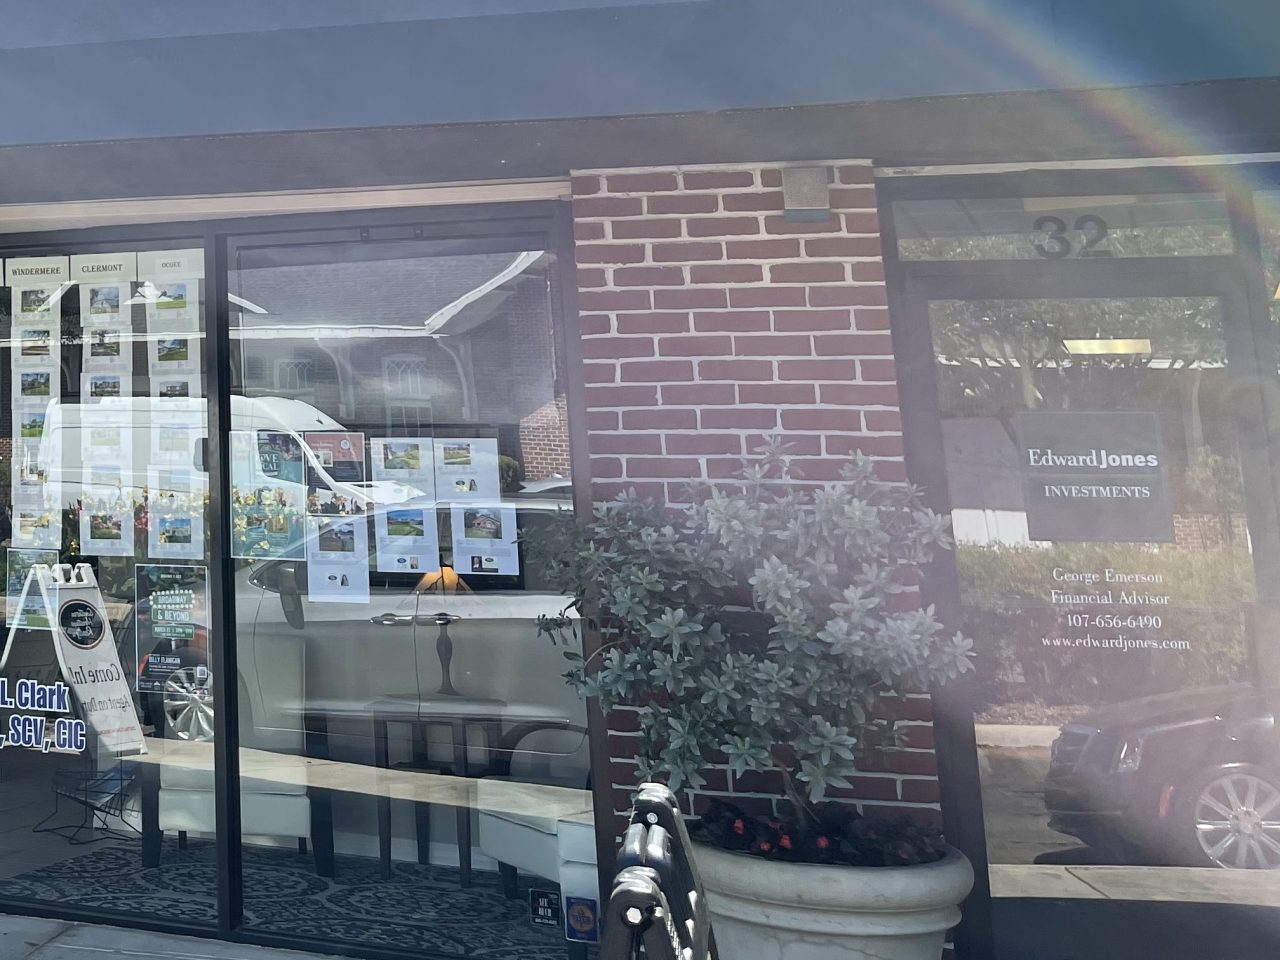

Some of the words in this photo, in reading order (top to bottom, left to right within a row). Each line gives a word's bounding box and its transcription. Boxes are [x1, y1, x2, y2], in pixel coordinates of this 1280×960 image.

[1033, 214, 1112, 259] 32
[11, 266, 61, 276] WINDERMERE
[81, 264, 123, 273] CLERMONT
[1044, 486, 1151, 498] INVESTMENTS
[1052, 567, 1100, 586] George
[1105, 568, 1163, 583] Emerson
[1051, 589, 1113, 605] Financial
[1119, 591, 1170, 606] Advisor
[164, 610, 190, 621] BEYOND
[1041, 634, 1191, 652] www.edwardjones.com
[16, 679, 70, 713] Clark
[8, 714, 51, 753] SCV,
[54, 717, 87, 752] CIC
